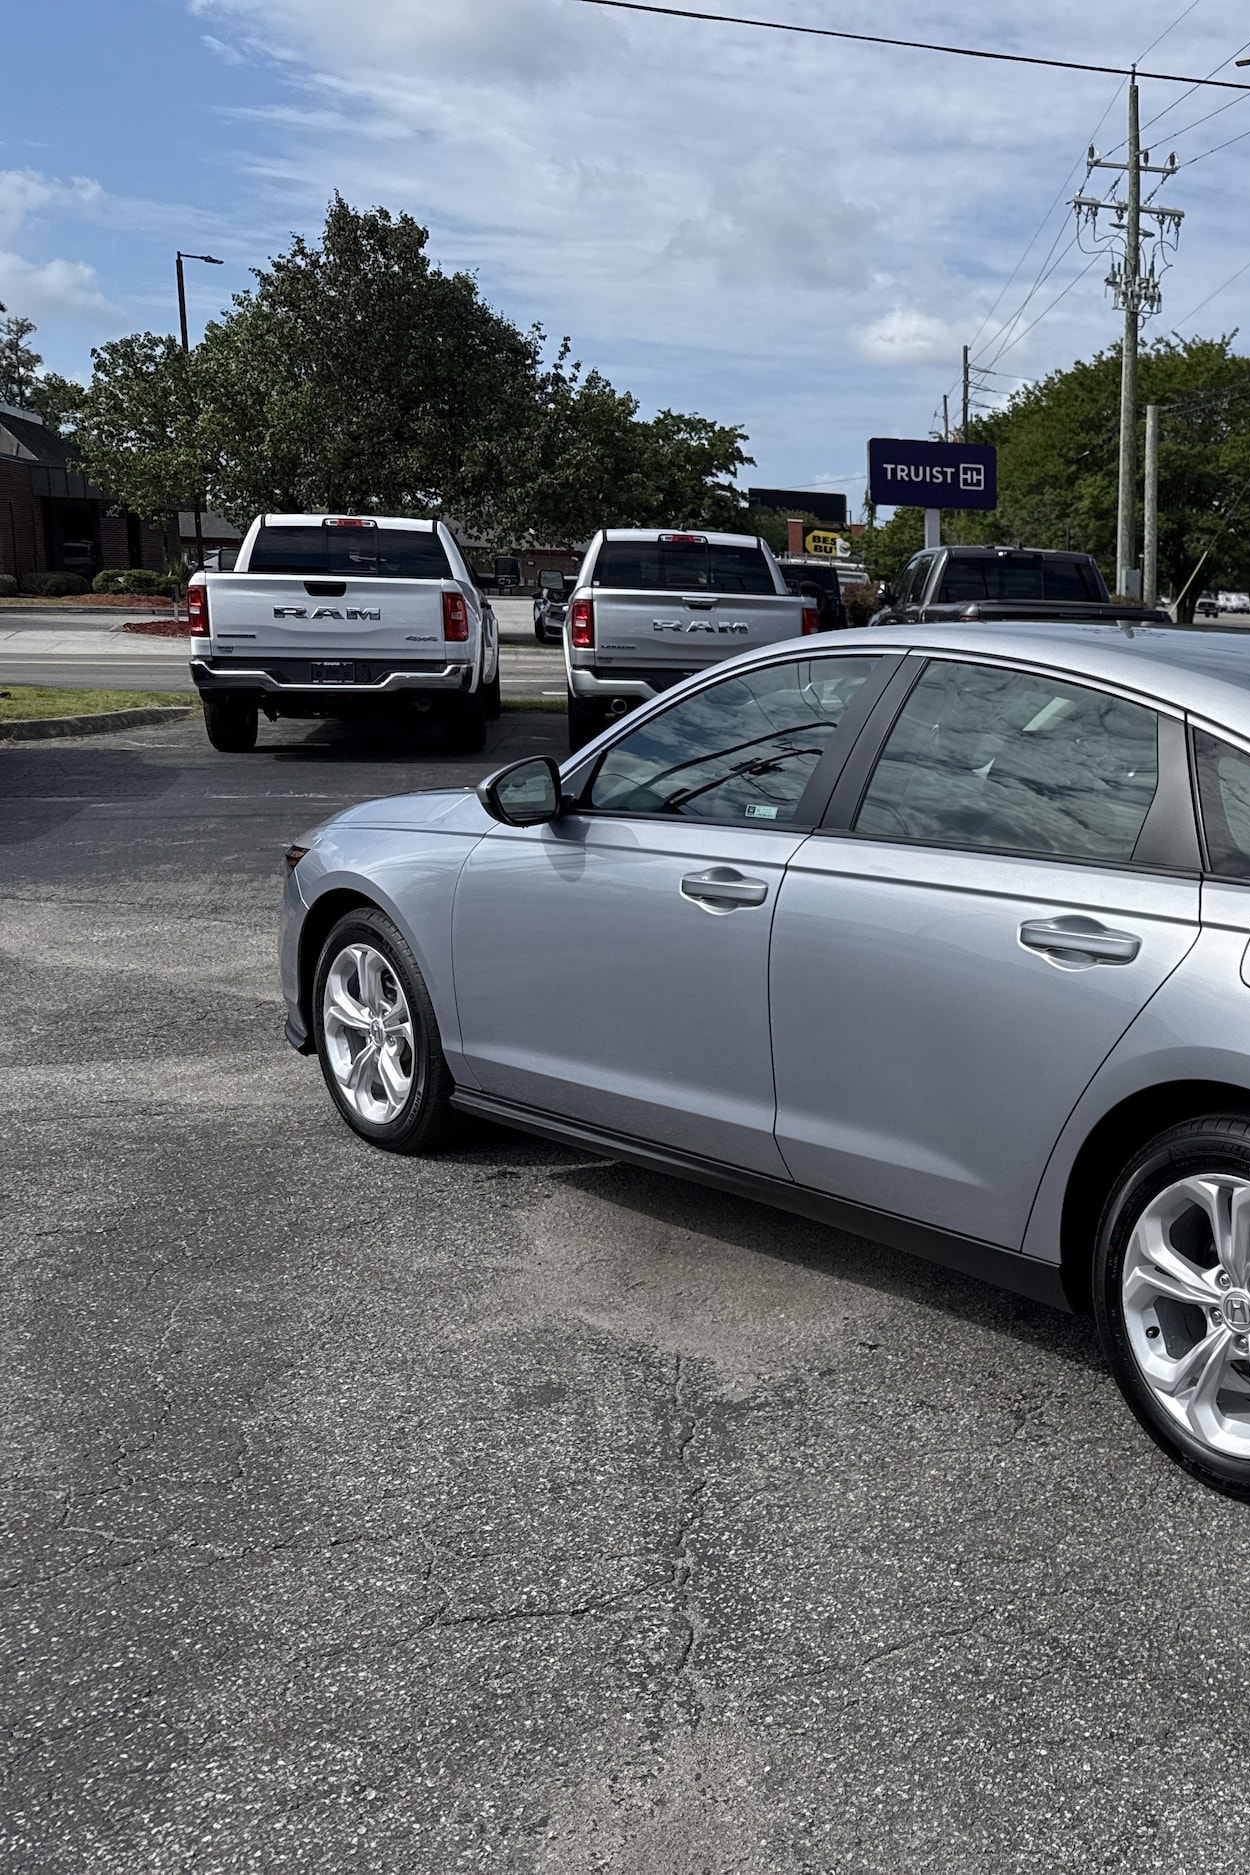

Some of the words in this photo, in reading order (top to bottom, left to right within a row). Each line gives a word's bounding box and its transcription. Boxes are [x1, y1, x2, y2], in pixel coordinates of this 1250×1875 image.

[882, 463, 956, 484] TRUIST
[812, 535, 838, 546] BES
[273, 605, 381, 621] RAM
[652, 619, 750, 635] RAM
